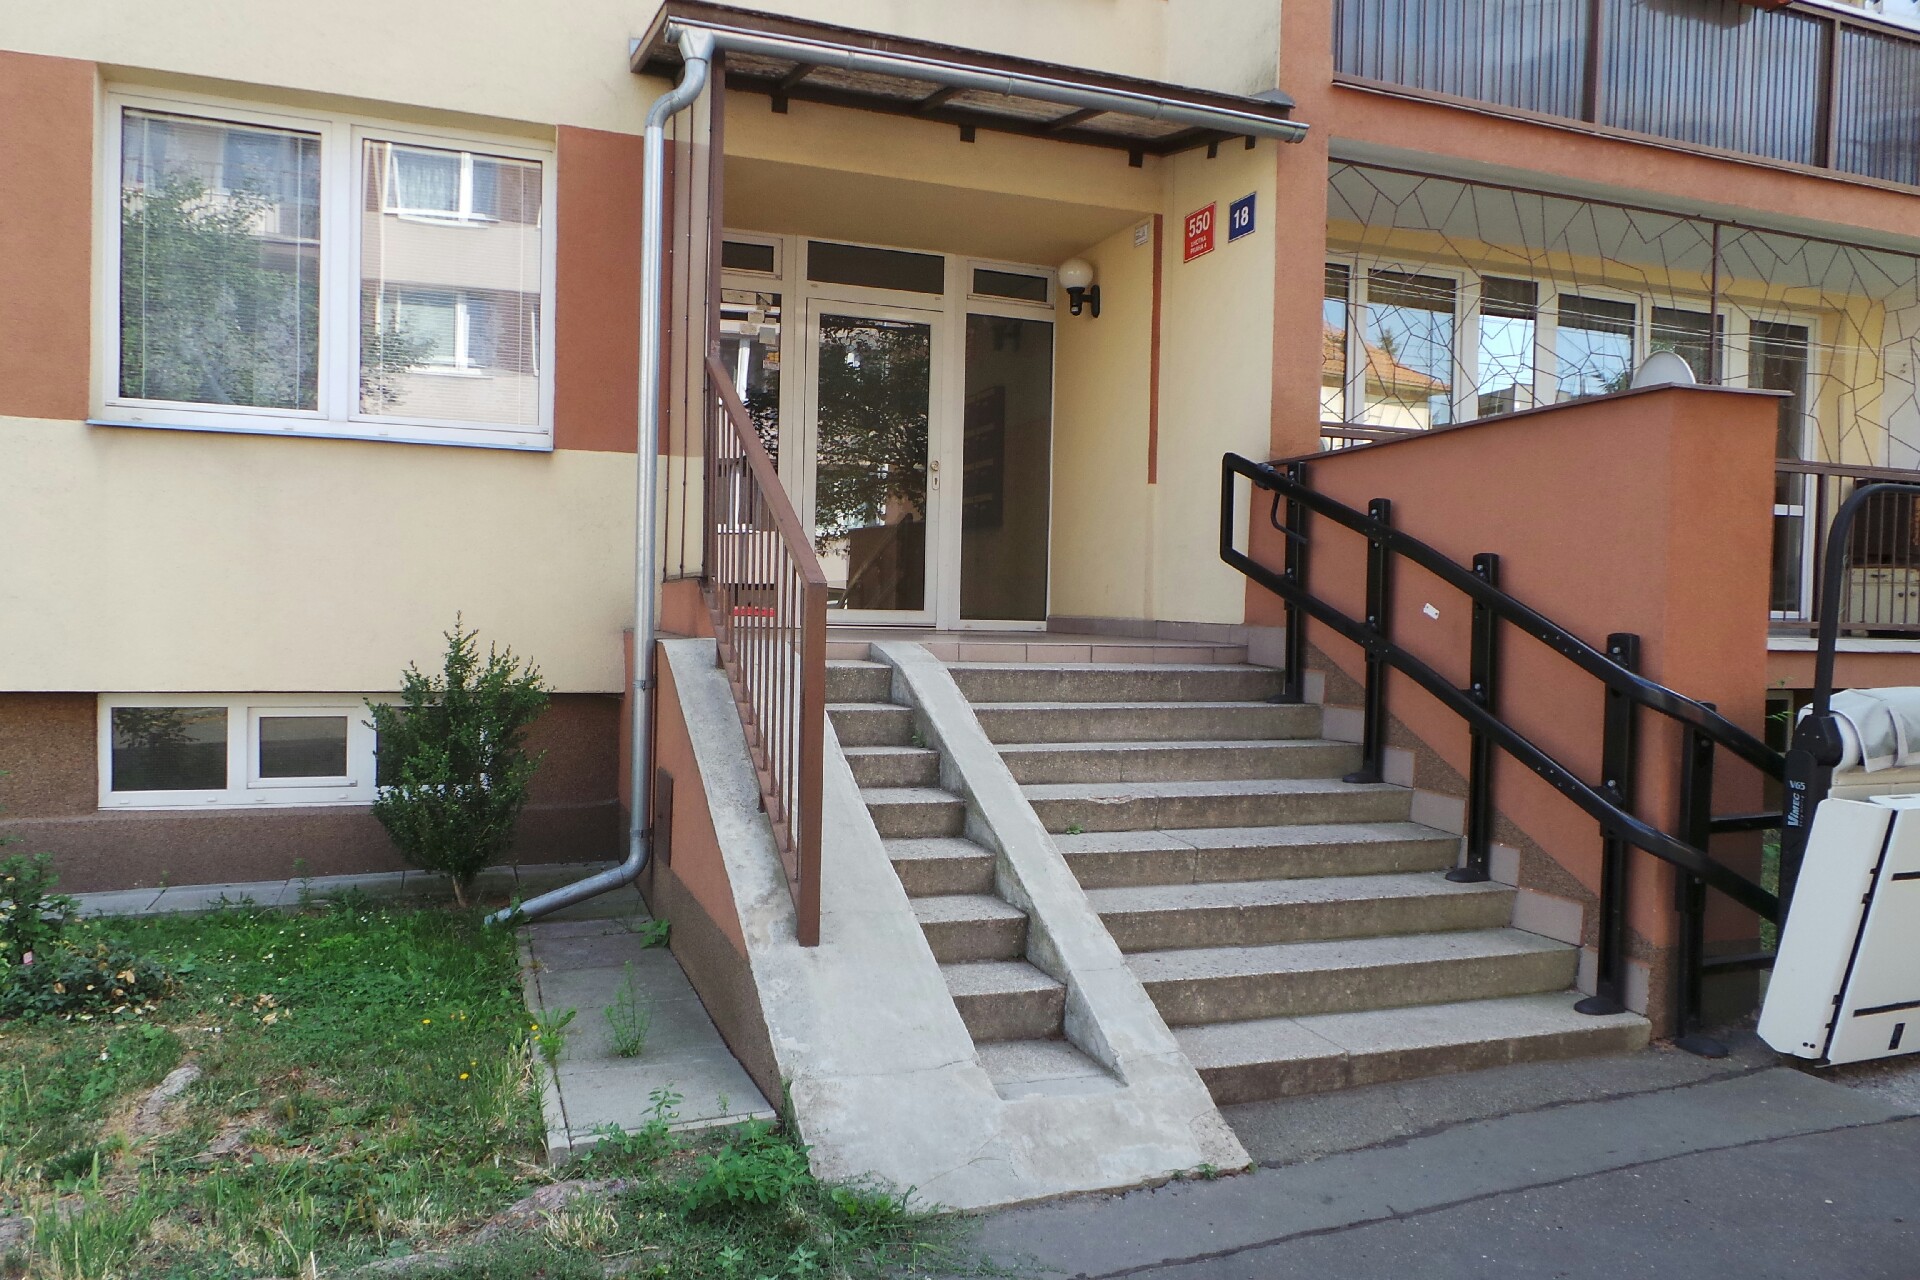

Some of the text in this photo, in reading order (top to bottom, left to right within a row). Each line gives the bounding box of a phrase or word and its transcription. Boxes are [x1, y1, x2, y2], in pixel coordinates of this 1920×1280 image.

[1189, 211, 1211, 238] 550
[1234, 206, 1249, 229] 18
[1789, 780, 1806, 791] V65
